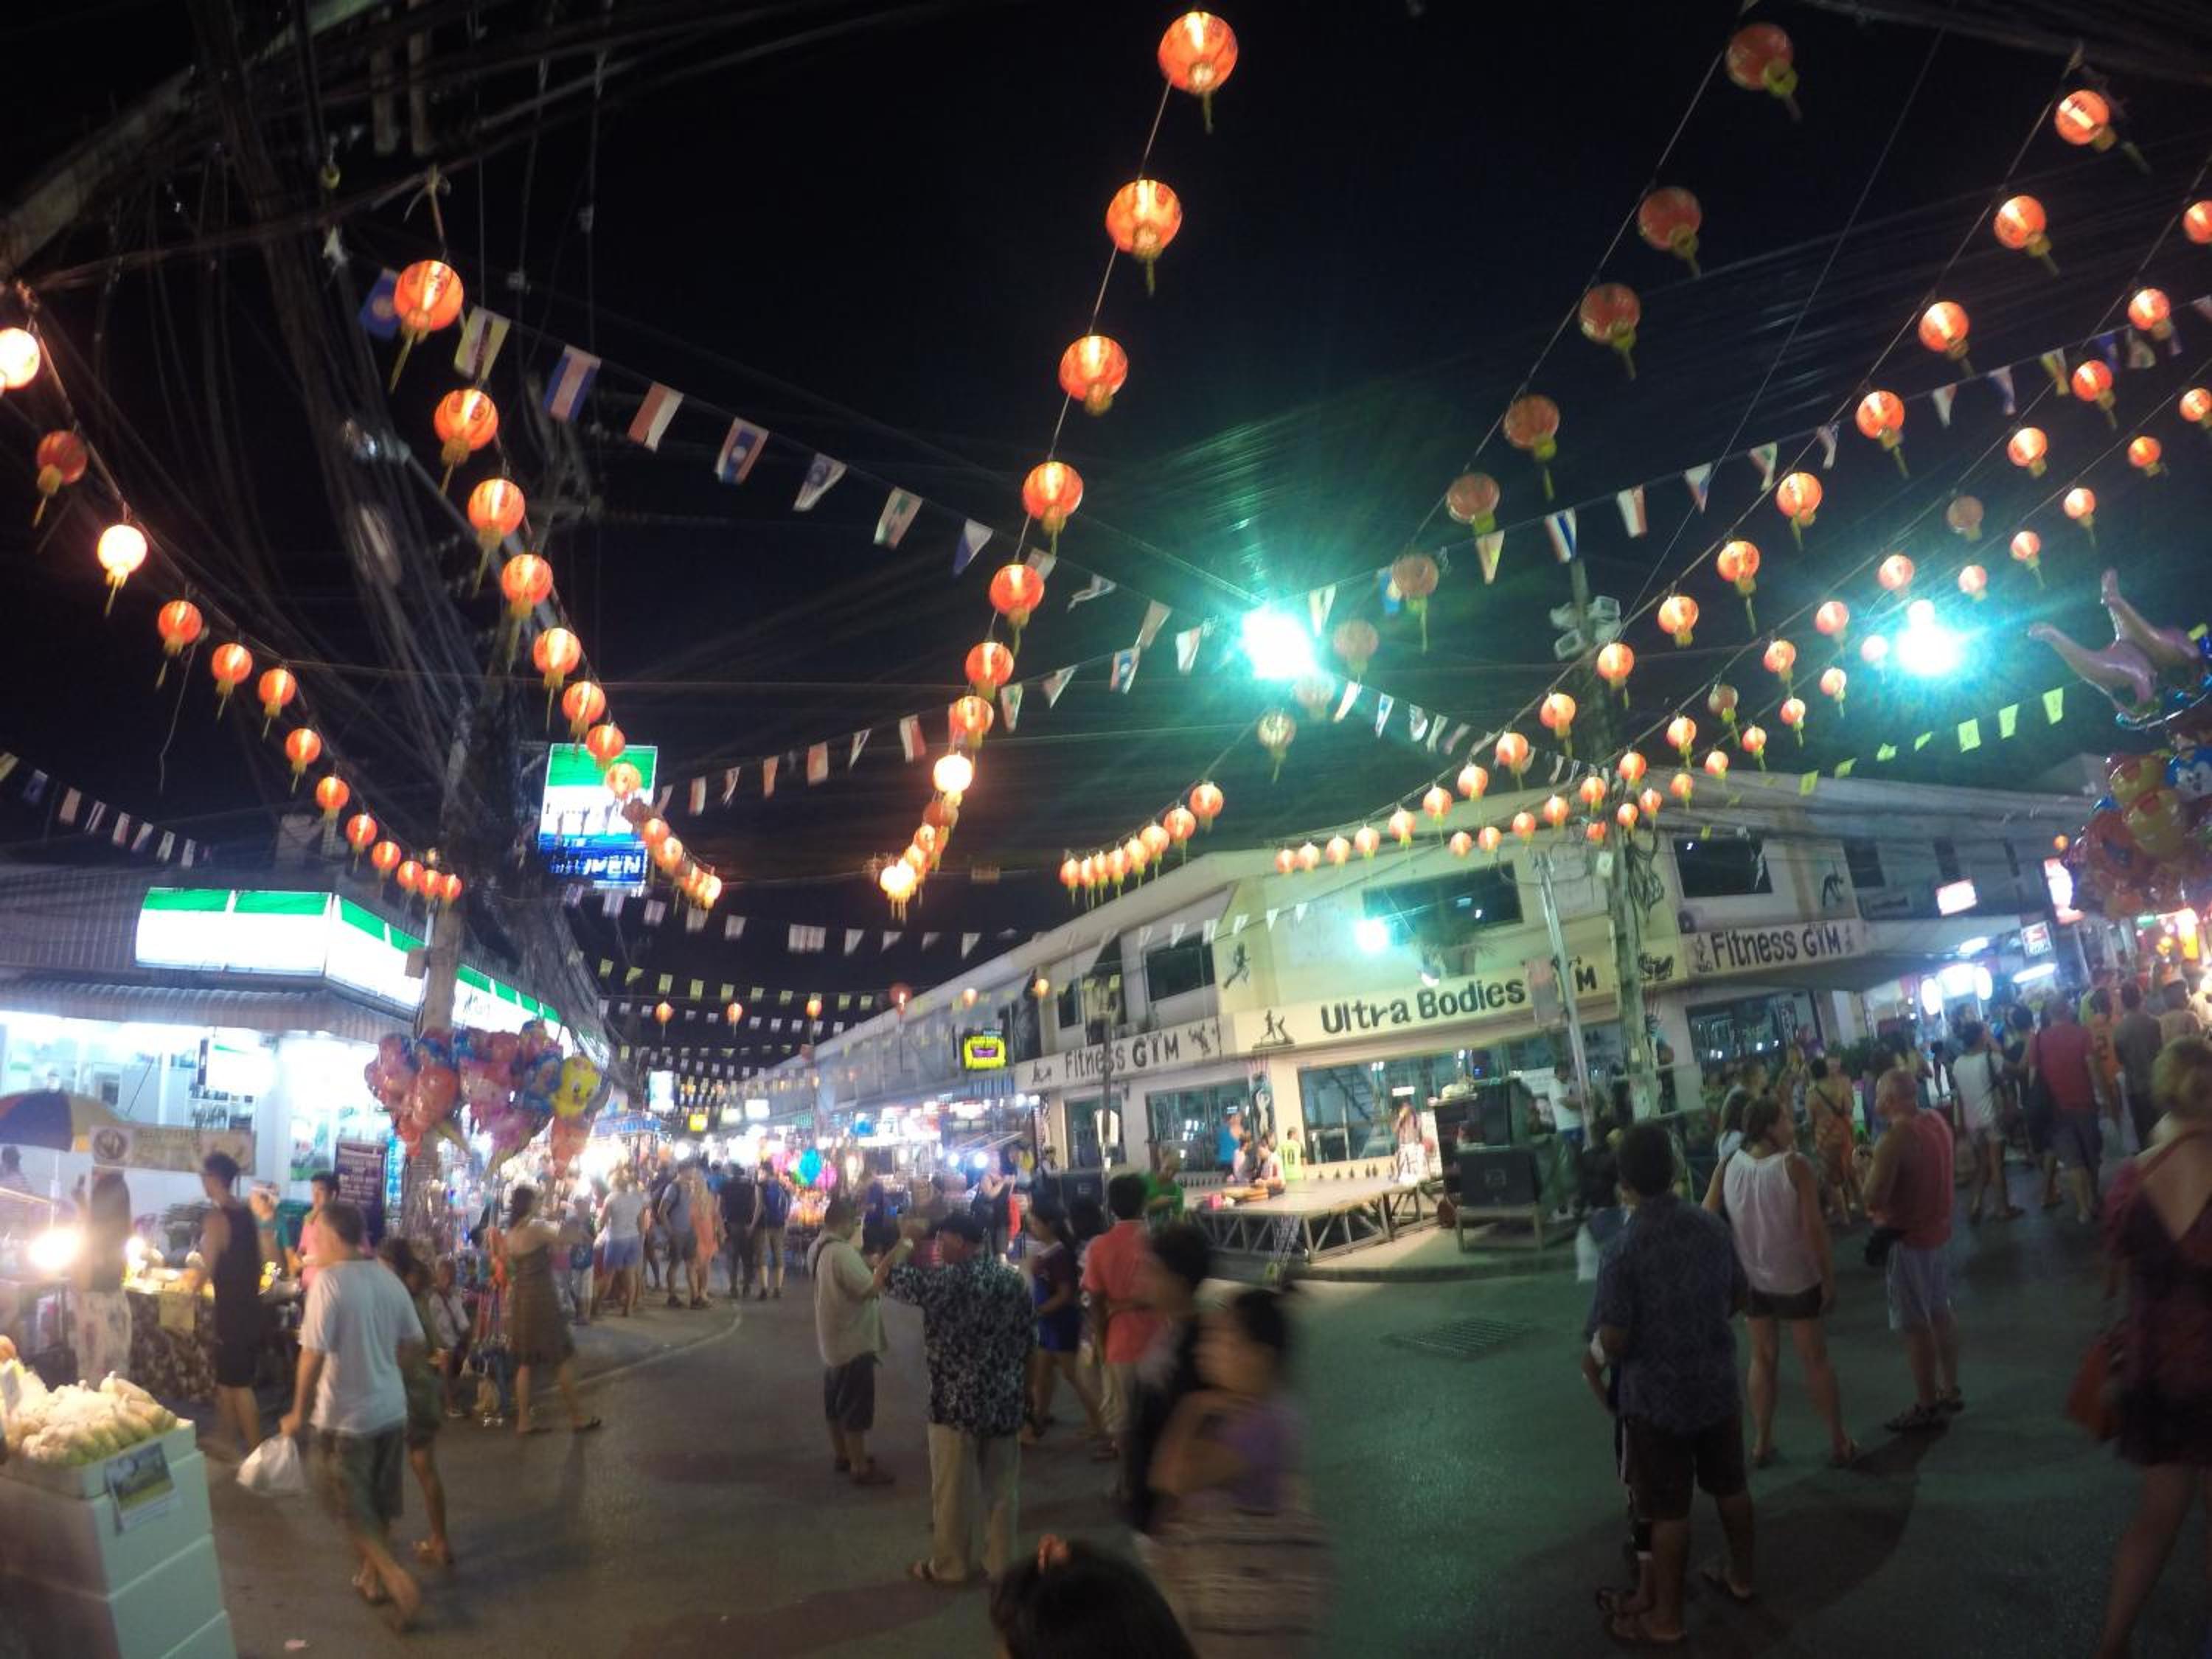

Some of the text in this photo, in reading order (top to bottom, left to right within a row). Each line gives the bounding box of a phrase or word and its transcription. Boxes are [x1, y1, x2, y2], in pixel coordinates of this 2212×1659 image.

[1710, 924, 1841, 968] Fitness GYM
[1321, 1000, 1411, 1034] Ultra
[1416, 978, 1526, 1019] Bodies
[1132, 1032, 1179, 1068] GYM
